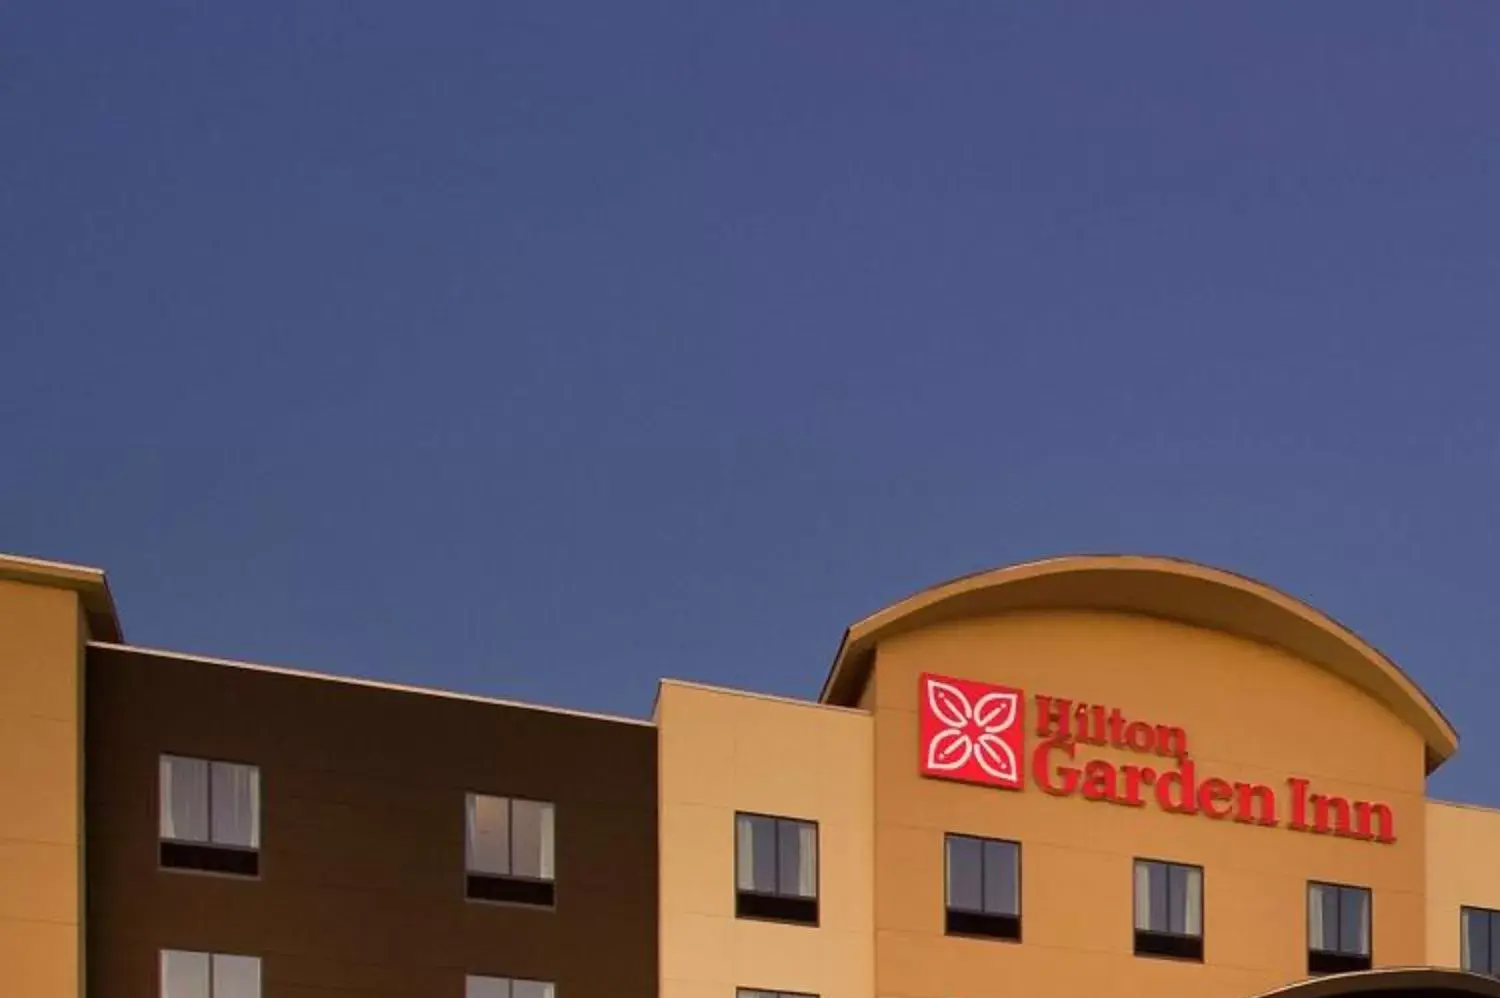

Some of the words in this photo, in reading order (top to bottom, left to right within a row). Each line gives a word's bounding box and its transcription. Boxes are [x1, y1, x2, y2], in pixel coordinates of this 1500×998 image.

[1035, 694, 1188, 758] Hilton
[1032, 737, 1278, 827] Garden
[1286, 777, 1397, 844] Inn
